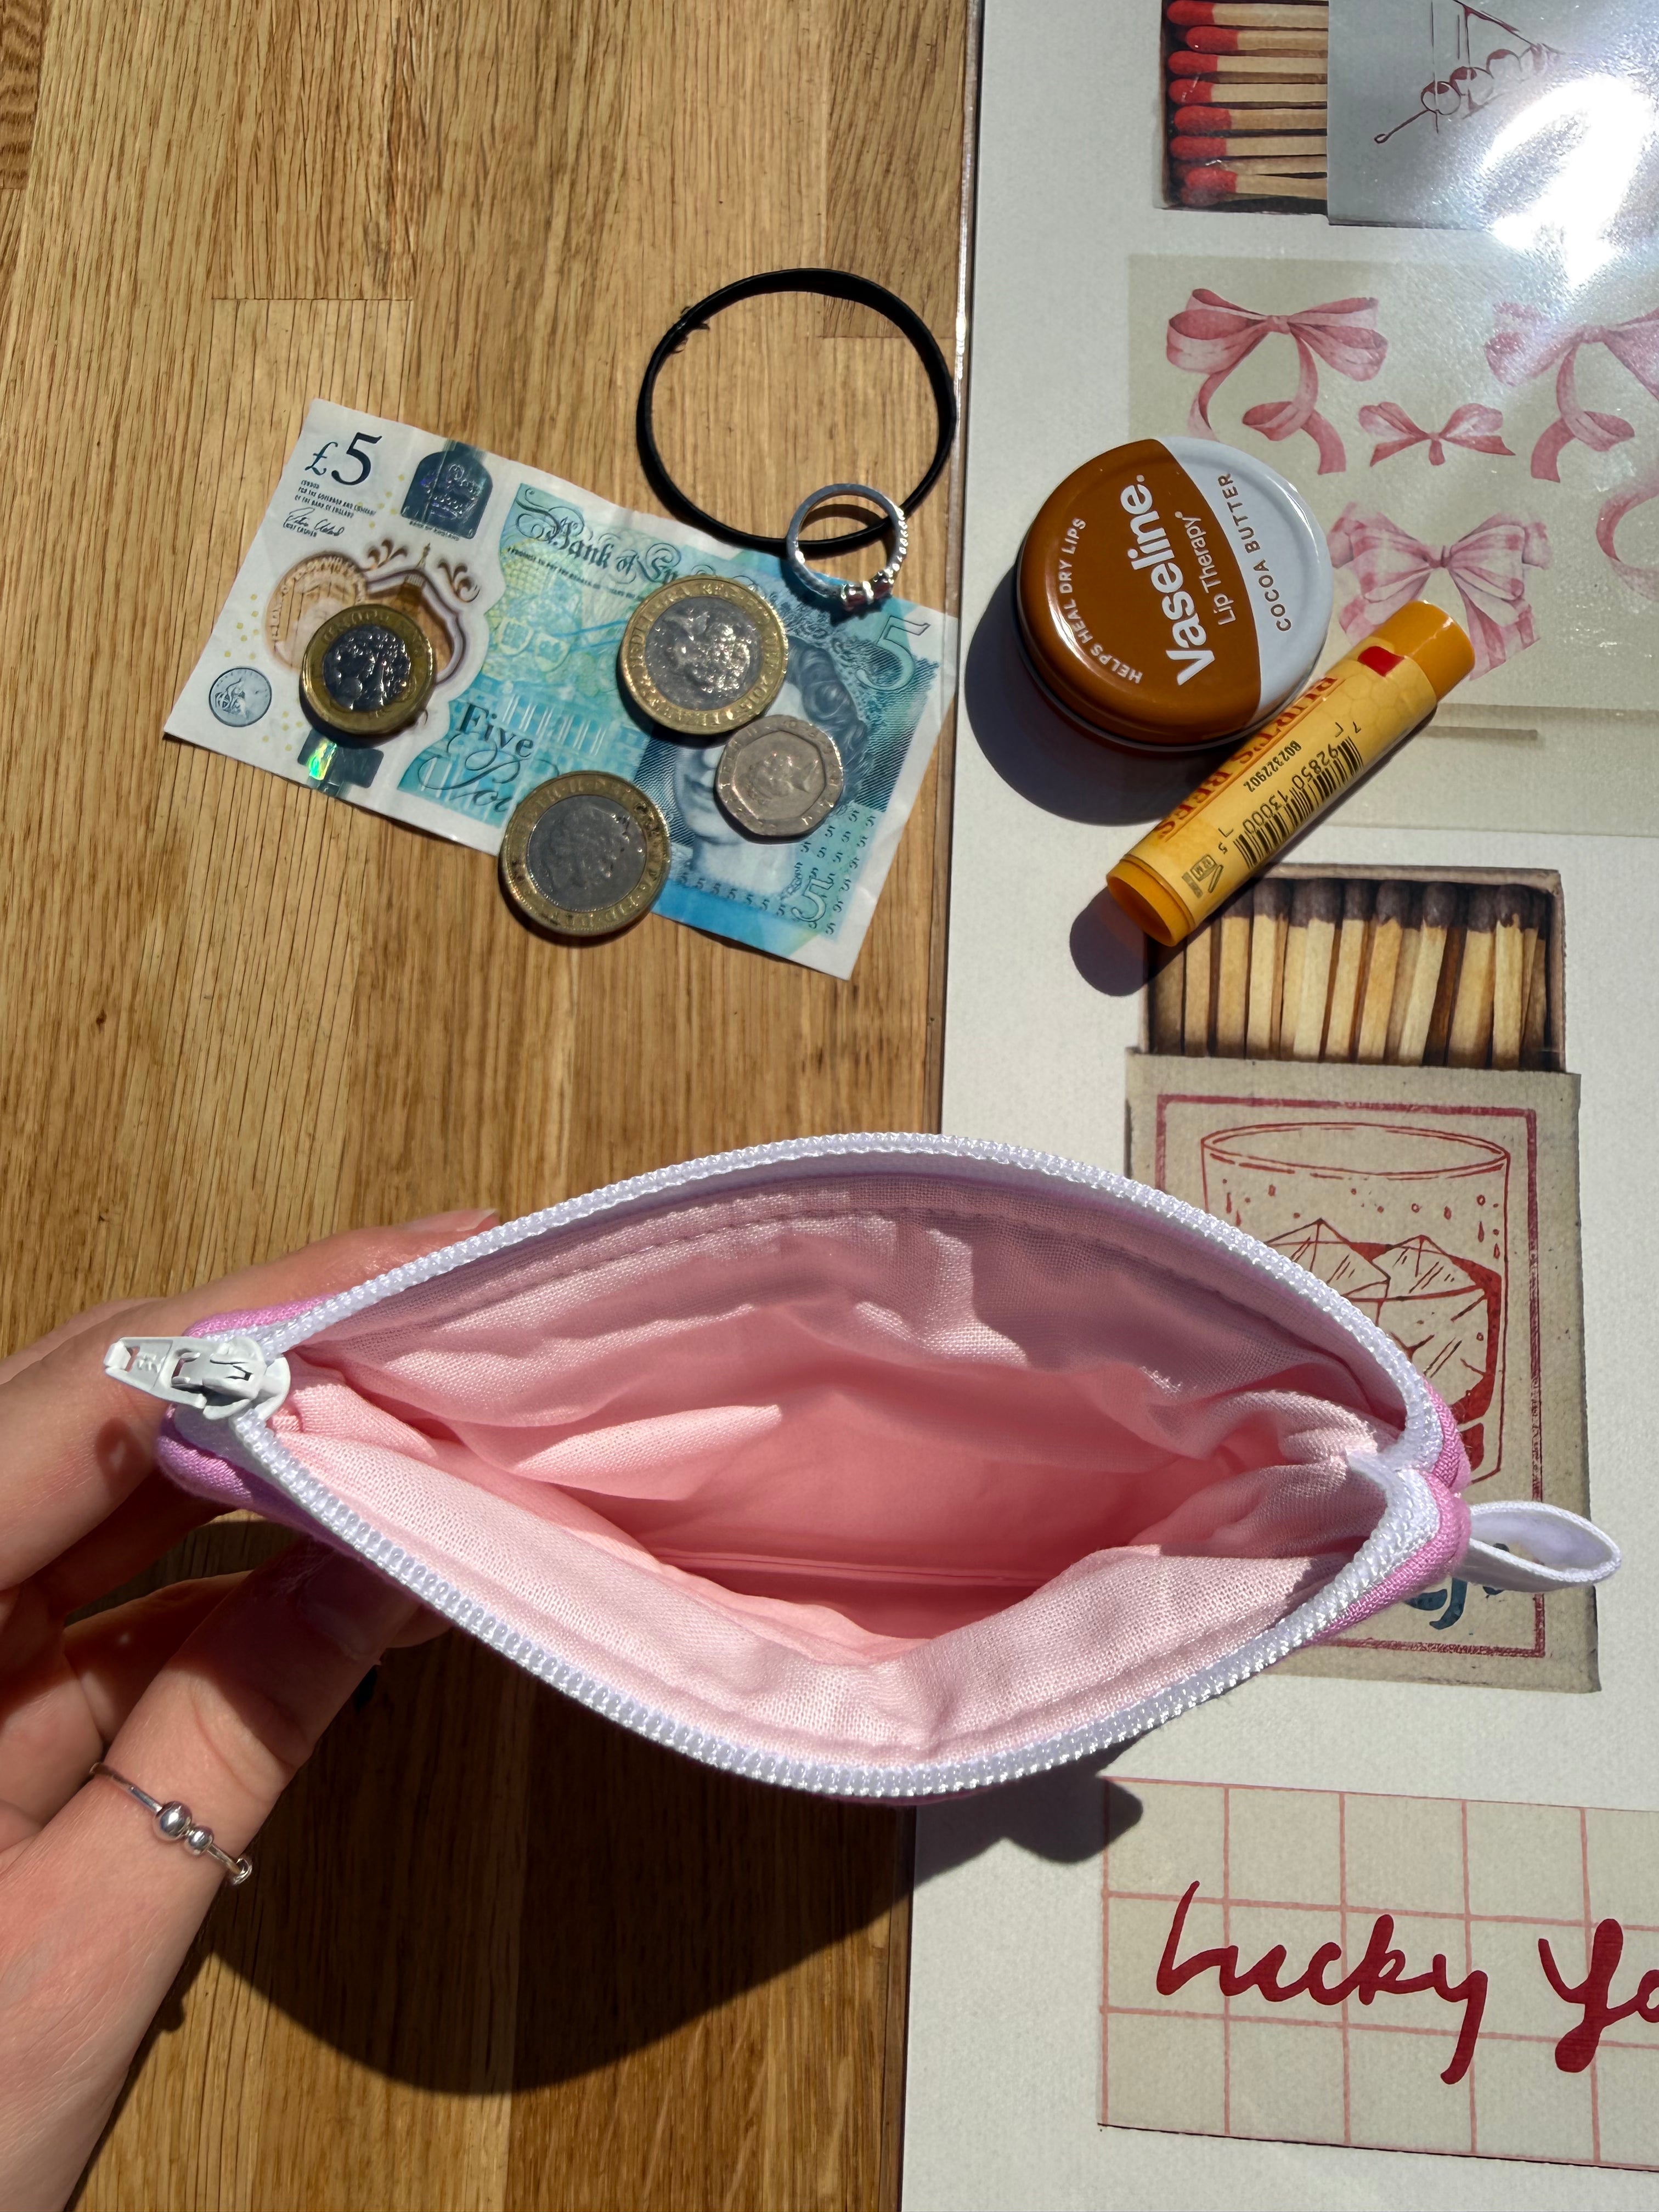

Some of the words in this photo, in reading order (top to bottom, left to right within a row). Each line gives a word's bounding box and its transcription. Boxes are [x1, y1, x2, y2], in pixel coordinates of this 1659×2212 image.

[304, 432, 382, 486] £5
[520, 502, 614, 569] Bank
[1061, 517, 1086, 554] LIPS
[1217, 473, 1261, 554] BUTTER
[1058, 559, 1073, 594] DRY
[1182, 516, 1222, 594] Therapy
[1120, 483, 1216, 686] Vaseline
[1253, 558, 1291, 631] COCOA
[1063, 598, 1093, 644] HEAL
[1214, 593, 1237, 625] Lip
[855, 615, 932, 692] 5
[1090, 643, 1143, 684] HELPS
[458, 703, 533, 758] Five
[1352, 721, 1362, 734] 7
[1291, 743, 1339, 790] 92850
[1242, 790, 1289, 834] 13000
[1218, 842, 1228, 855] 5
[791, 878, 835, 923] 5
[1156, 1880, 1488, 2085] Lucky
